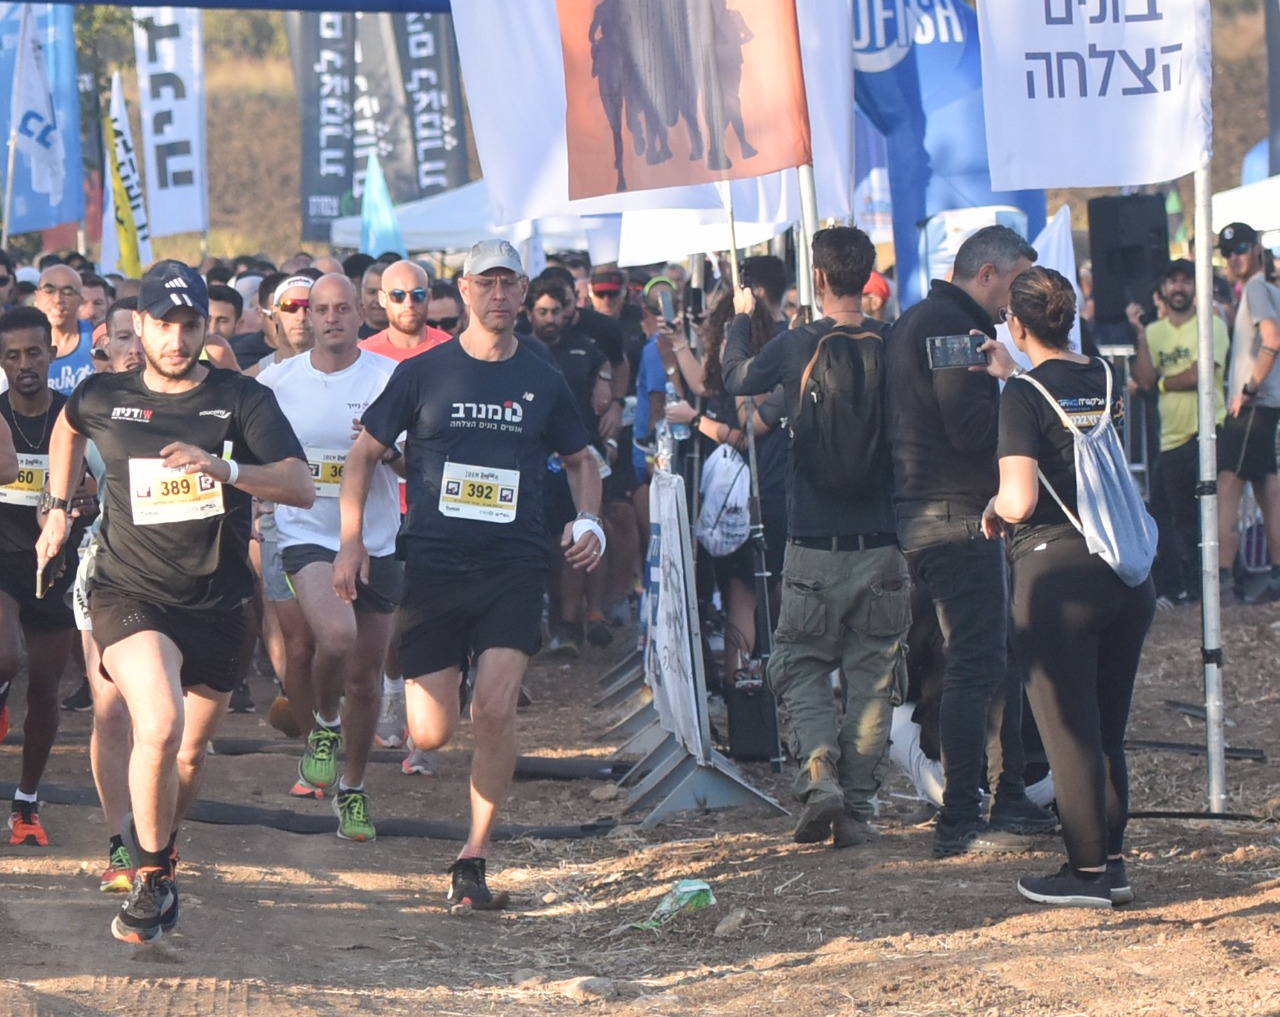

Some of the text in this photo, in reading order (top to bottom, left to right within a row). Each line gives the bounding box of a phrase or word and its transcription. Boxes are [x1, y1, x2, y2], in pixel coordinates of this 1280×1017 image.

[1025, 43, 1182, 99] הצלחה
[451, 402, 502, 421] מנרב
[161, 479, 191, 496] 389
[467, 483, 493, 500] 392
